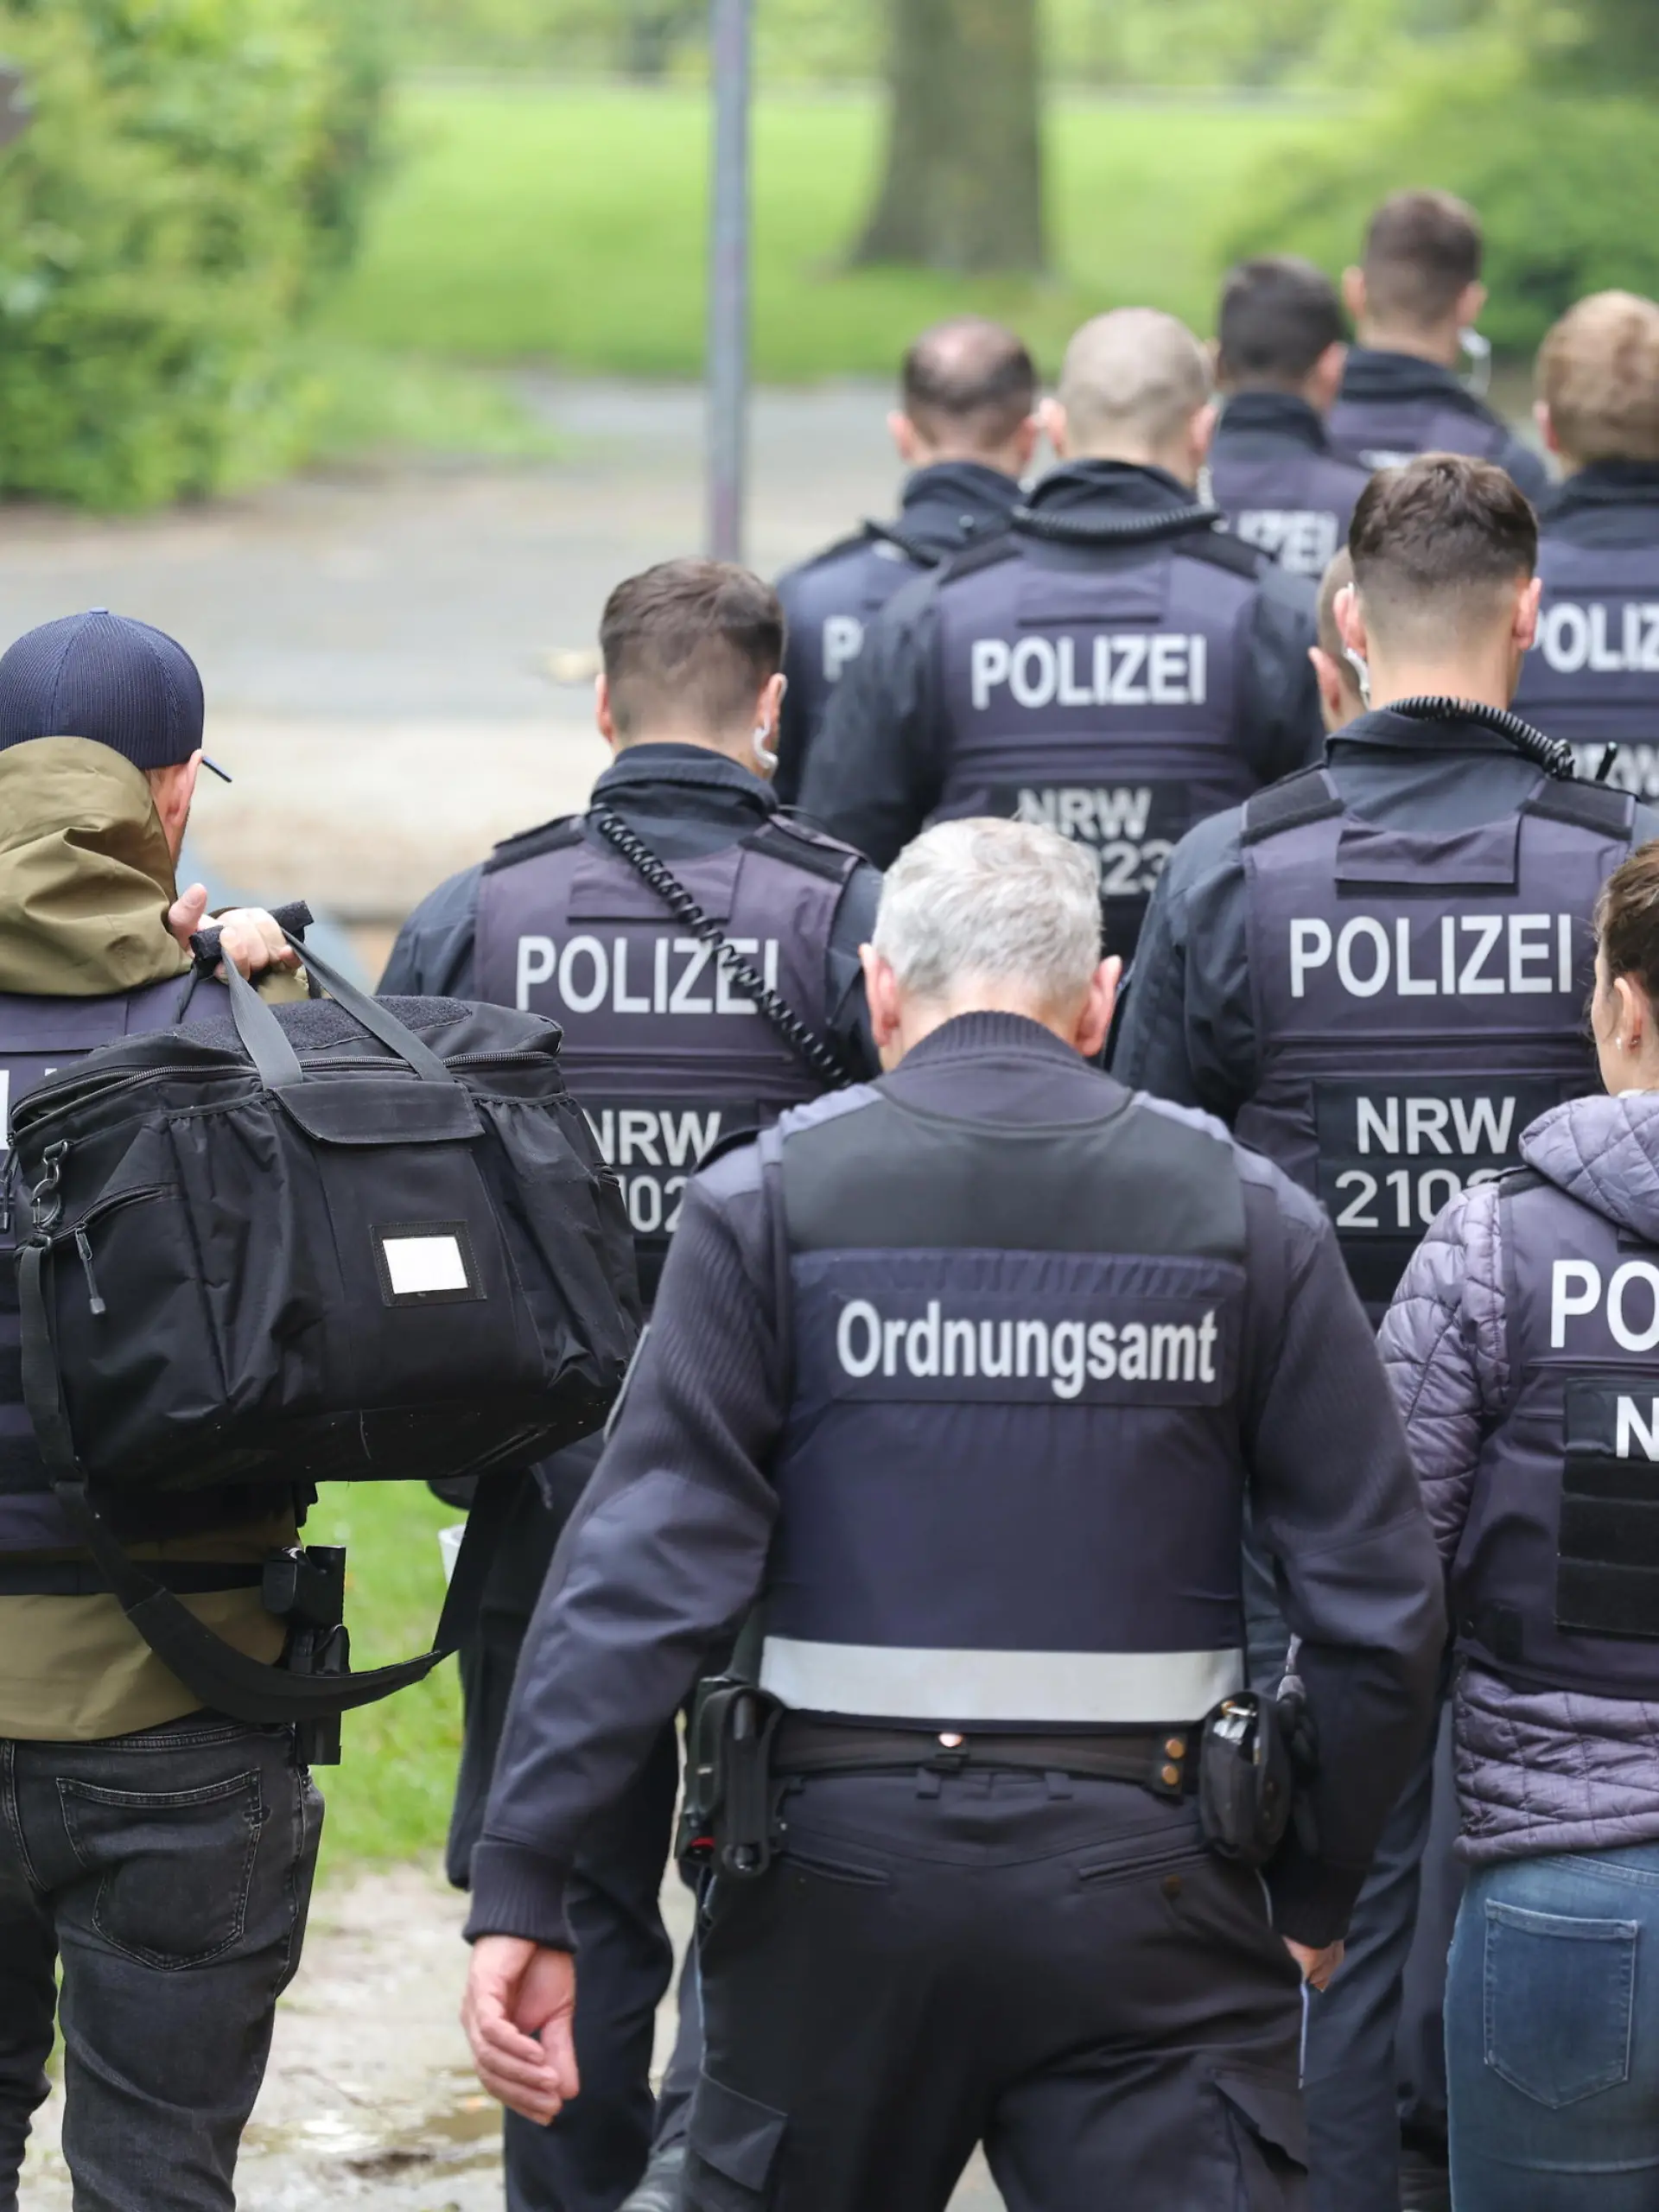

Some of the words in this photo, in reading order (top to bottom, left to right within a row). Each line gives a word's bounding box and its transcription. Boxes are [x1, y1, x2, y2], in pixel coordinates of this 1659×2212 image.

[971, 633, 1207, 710] POLIZEI
[1018, 787, 1153, 840] NRW
[516, 935, 779, 1014] POLIZEI
[1290, 913, 1572, 998] POLIZEI
[582, 1109, 722, 1166] NRW
[1357, 1096, 1516, 1154] NRW
[1335, 1168, 1502, 1228] 210
[1551, 1259, 1659, 1351] PO
[836, 1300, 1217, 1400] Ordnungsamt
